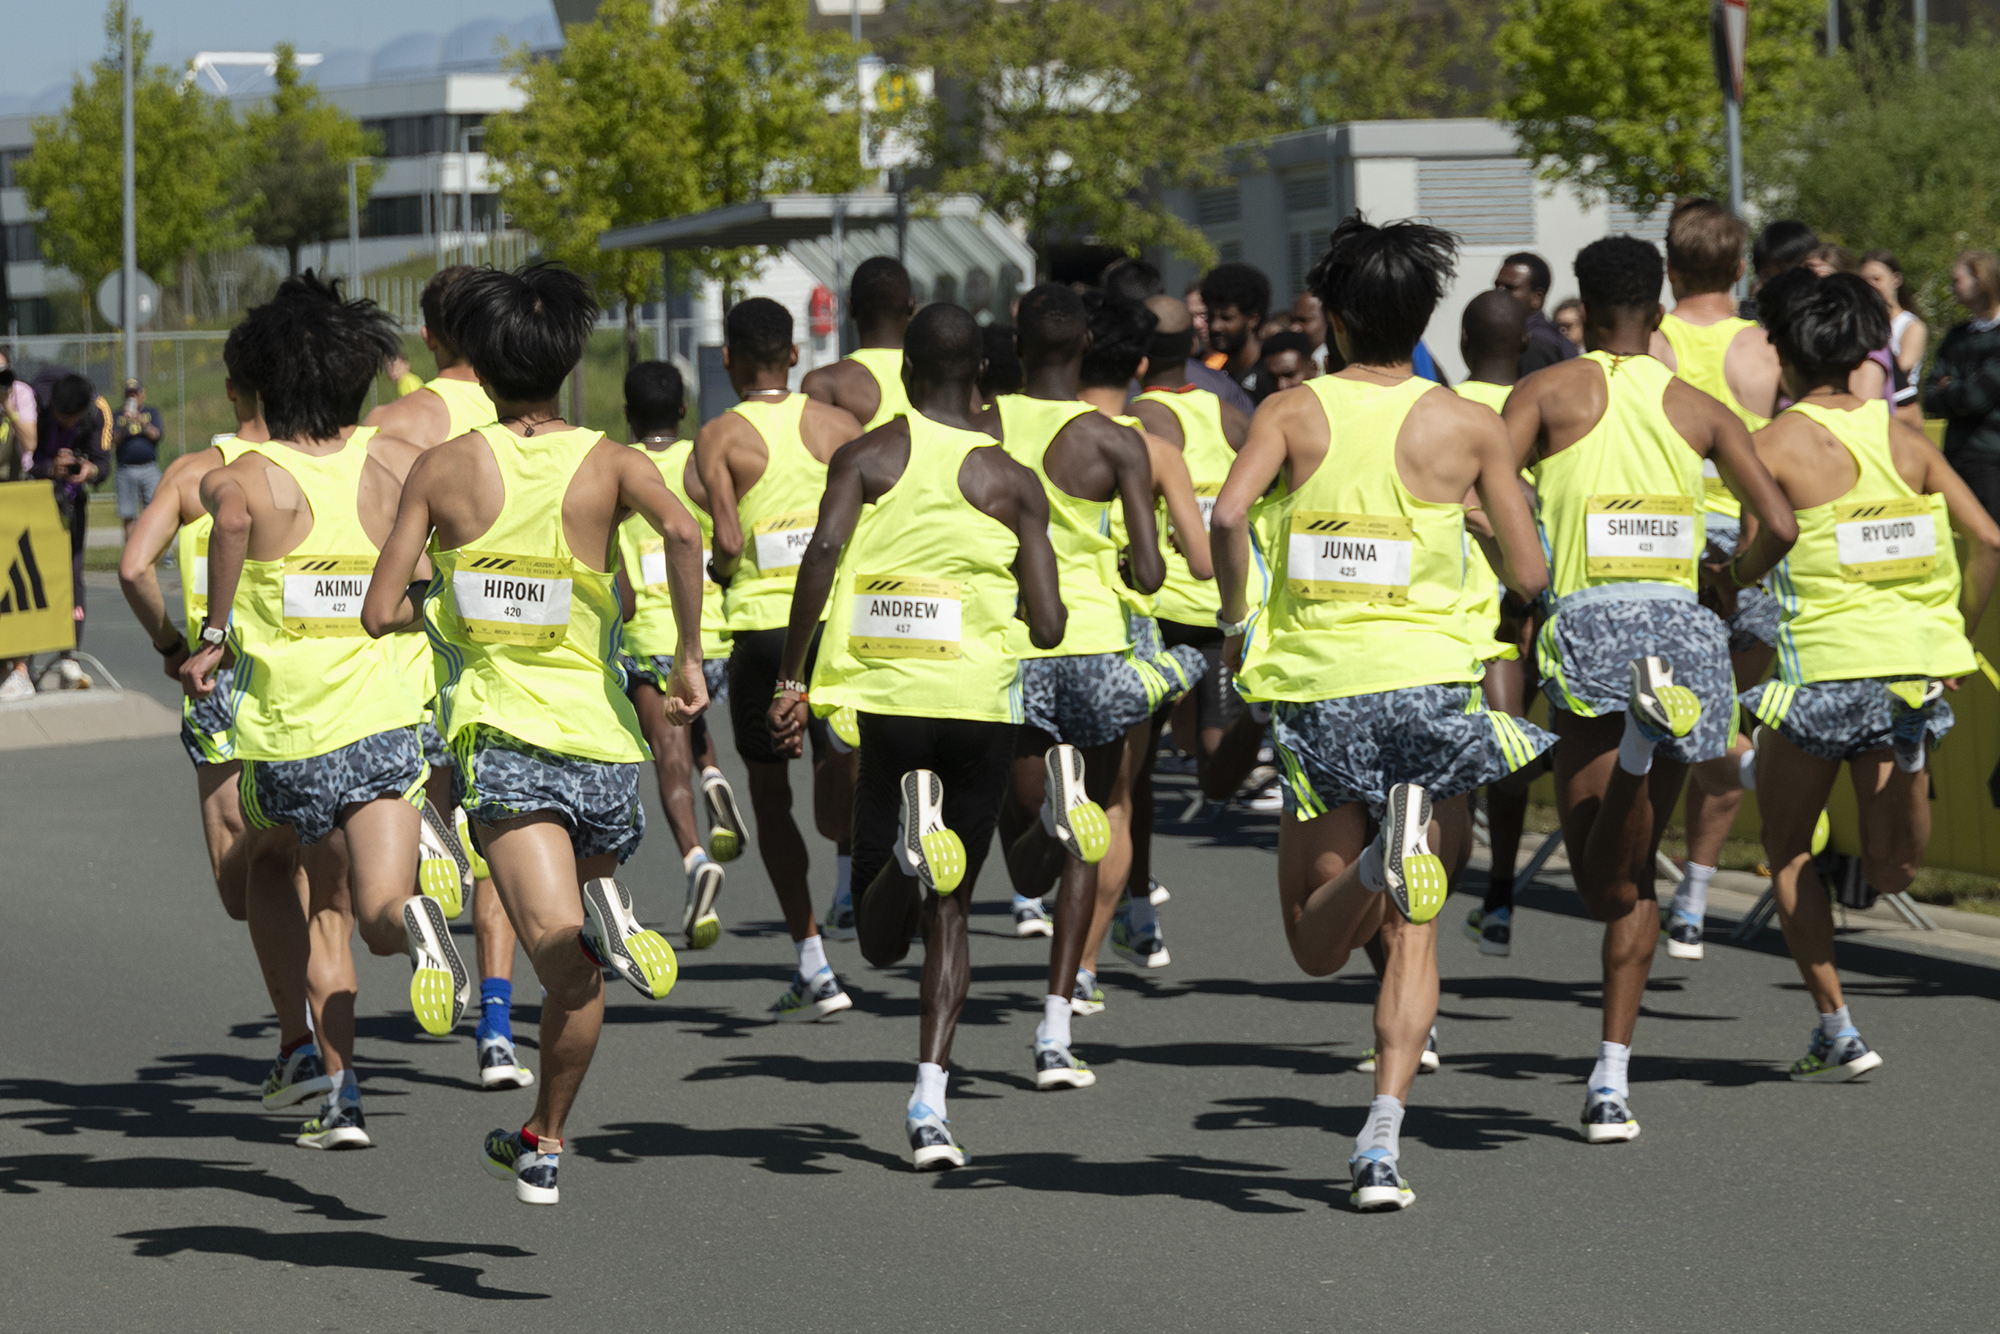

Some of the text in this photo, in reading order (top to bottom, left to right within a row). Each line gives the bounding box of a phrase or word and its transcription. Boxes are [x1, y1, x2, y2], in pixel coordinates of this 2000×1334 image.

[1607, 519, 1679, 537] SHIMELIS
[1861, 521, 1915, 542] RYUOTO
[786, 532, 814, 549] PAC
[1321, 541, 1377, 562] JUNNA
[1339, 566, 1357, 577] 425
[314, 580, 363, 597] AKIMU
[483, 579, 545, 602] HIROKI
[332, 603, 347, 612] 422
[503, 606, 522, 618] 420
[870, 600, 939, 619] ANDREW
[895, 623, 911, 633] 417
